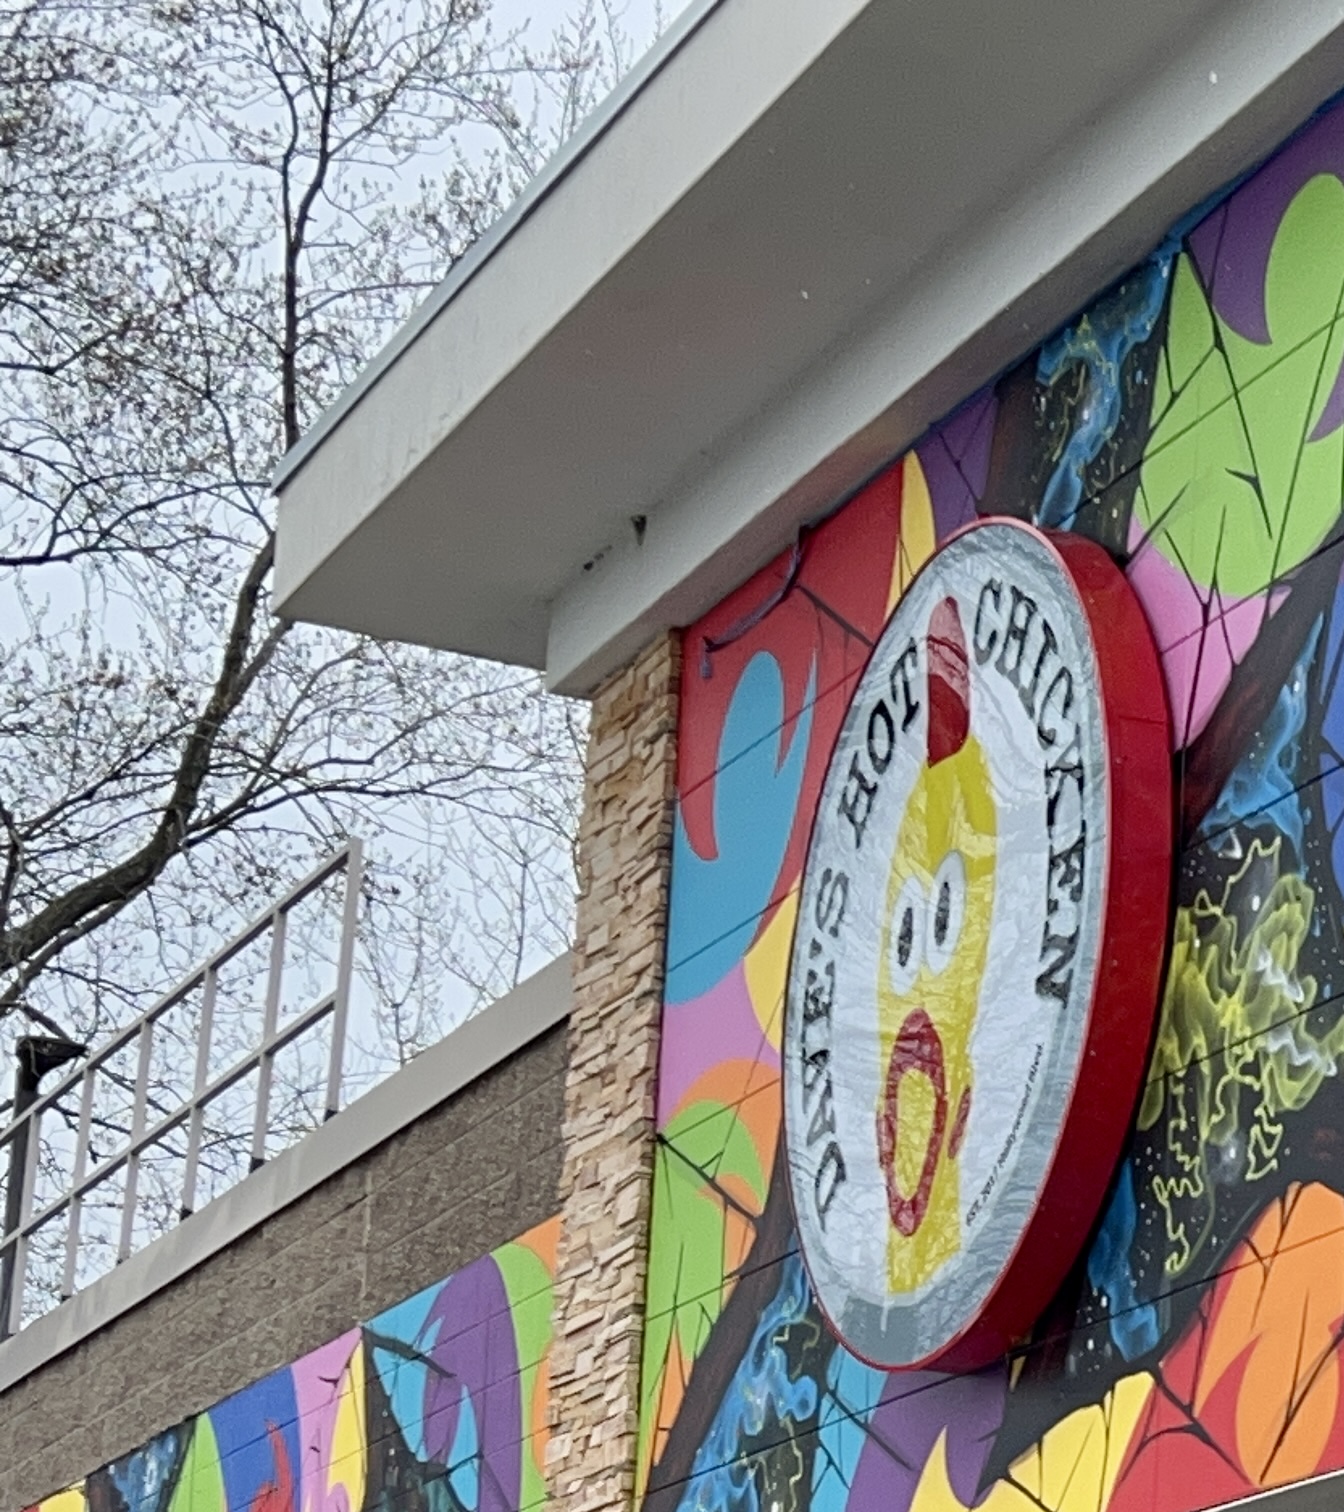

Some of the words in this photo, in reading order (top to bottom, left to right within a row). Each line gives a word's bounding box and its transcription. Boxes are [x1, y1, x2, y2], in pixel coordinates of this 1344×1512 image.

[801, 867, 849, 1232] DAVE'S
[837, 637, 922, 850] HOT
[973, 576, 1088, 1009] CHICKEN
